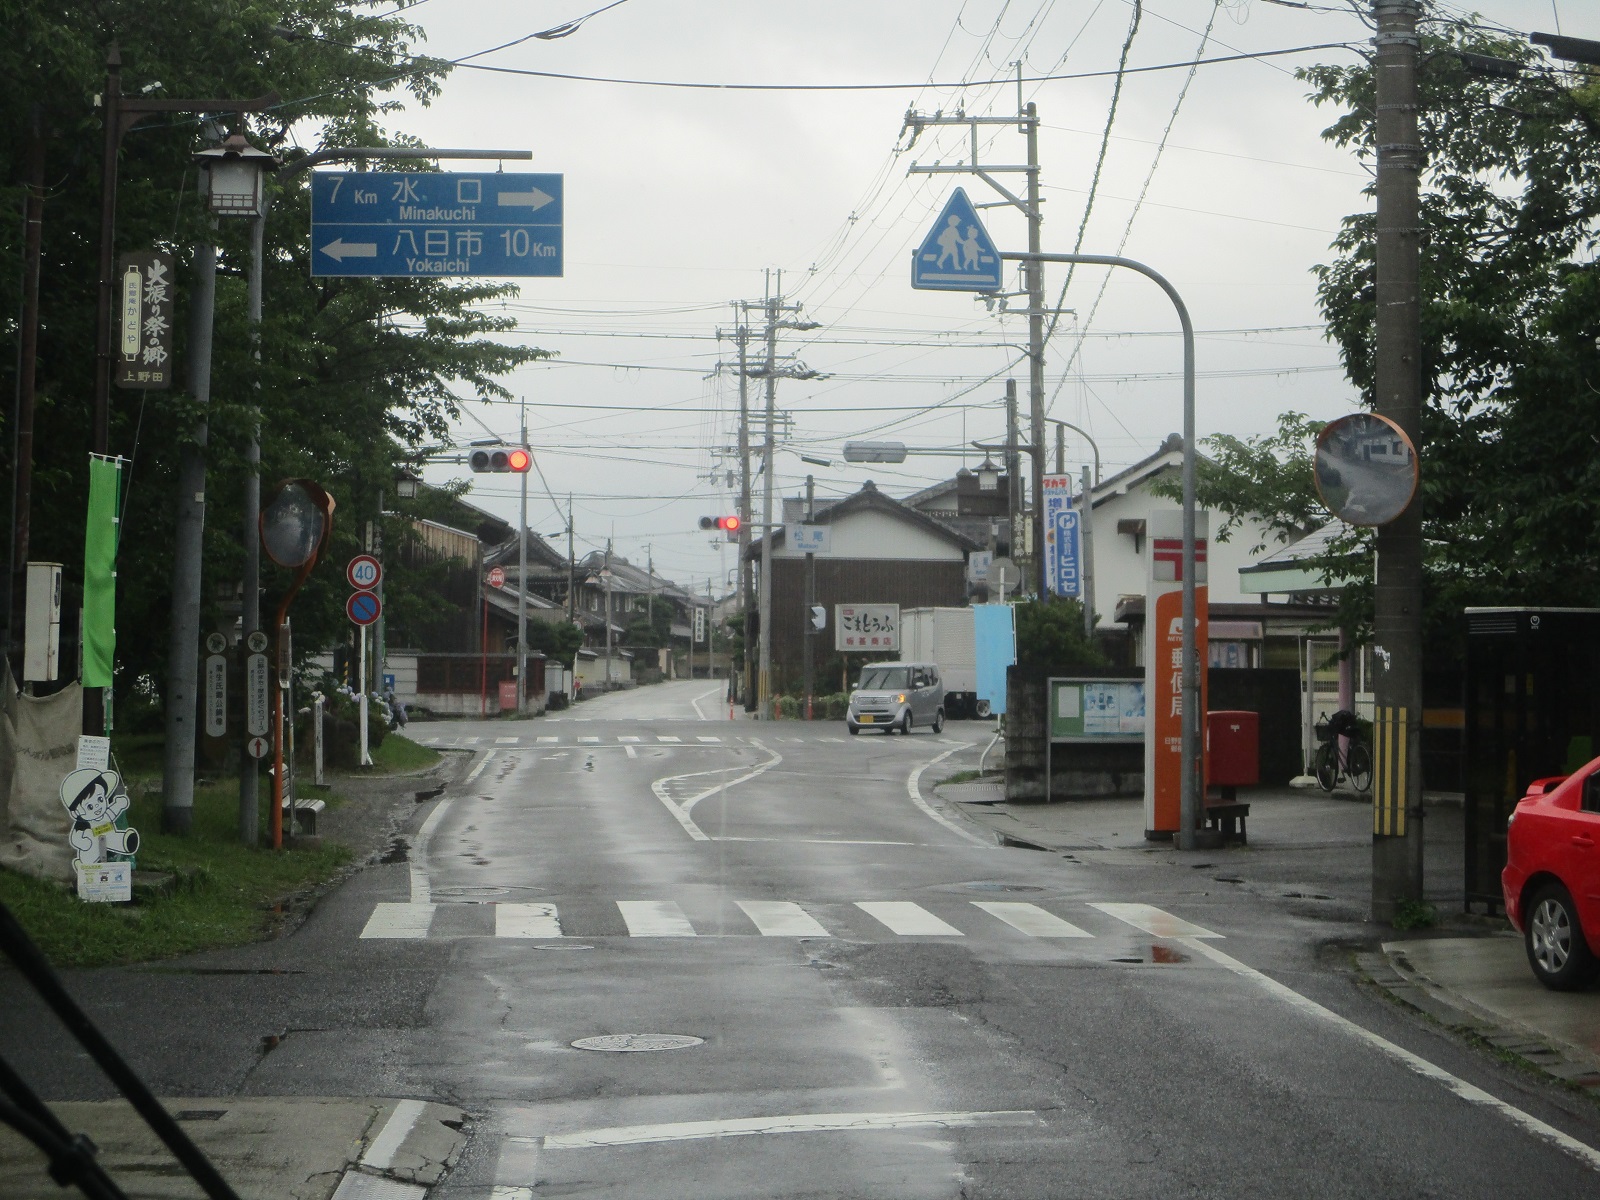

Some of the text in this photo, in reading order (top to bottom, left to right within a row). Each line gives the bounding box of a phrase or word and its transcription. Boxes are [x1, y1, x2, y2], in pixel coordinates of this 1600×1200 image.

[328, 177, 482, 204] 7 Km 水口
[399, 206, 476, 221] Minakuchi
[392, 229, 557, 257] 八日市 10 Km
[406, 258, 470, 273] Yokaichi
[142, 259, 170, 367] 火振り祭の郷
[123, 371, 163, 382] 上野田
[355, 565, 374, 580] 40
[1061, 555, 1076, 593] ヒロセ
